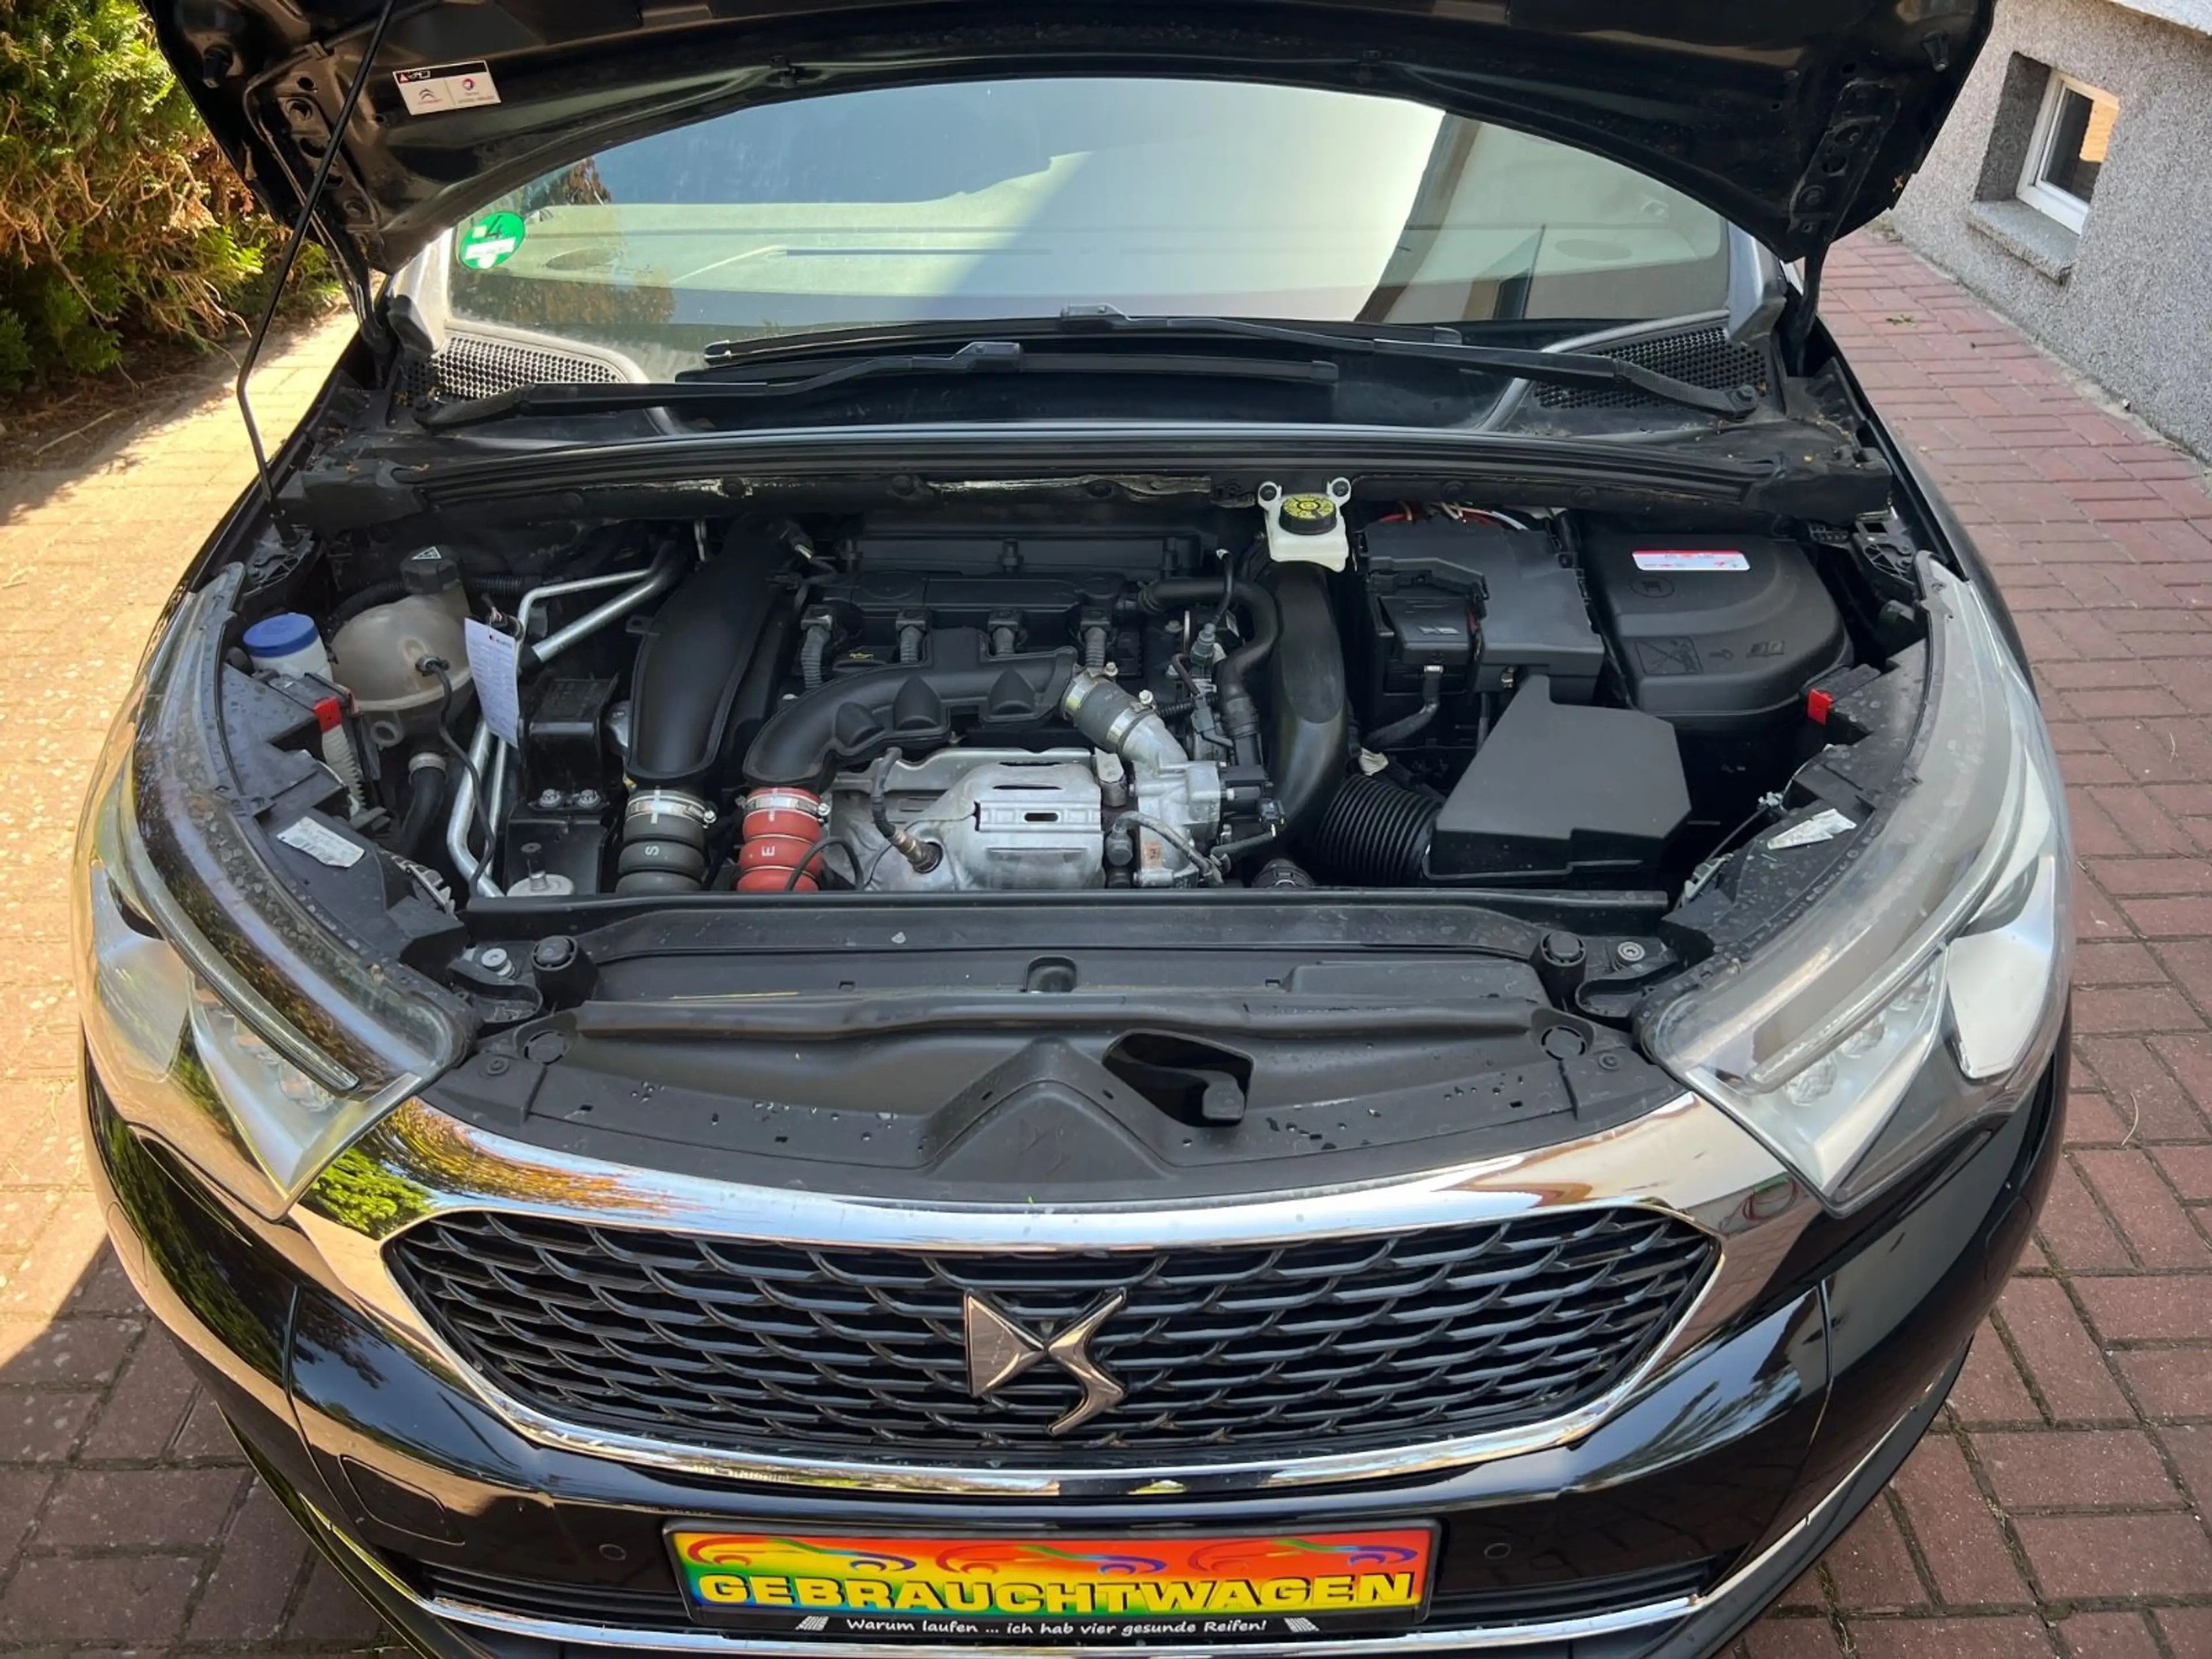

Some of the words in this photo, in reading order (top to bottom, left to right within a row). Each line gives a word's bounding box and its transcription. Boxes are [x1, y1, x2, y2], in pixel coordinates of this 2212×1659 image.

[645, 845, 660, 857] S
[762, 845, 775, 857] E
[699, 1572, 1415, 1613] GEBRAUCHTWAGEN
[846, 1618, 915, 1631] Warum
[922, 1619, 979, 1633] laufen
[1006, 1622, 1034, 1634] ich
[1040, 1622, 1074, 1634] hab
[1080, 1622, 1117, 1634] vier
[1121, 1620, 1196, 1637] gesunde
[1203, 1619, 1267, 1633] Reifen!
